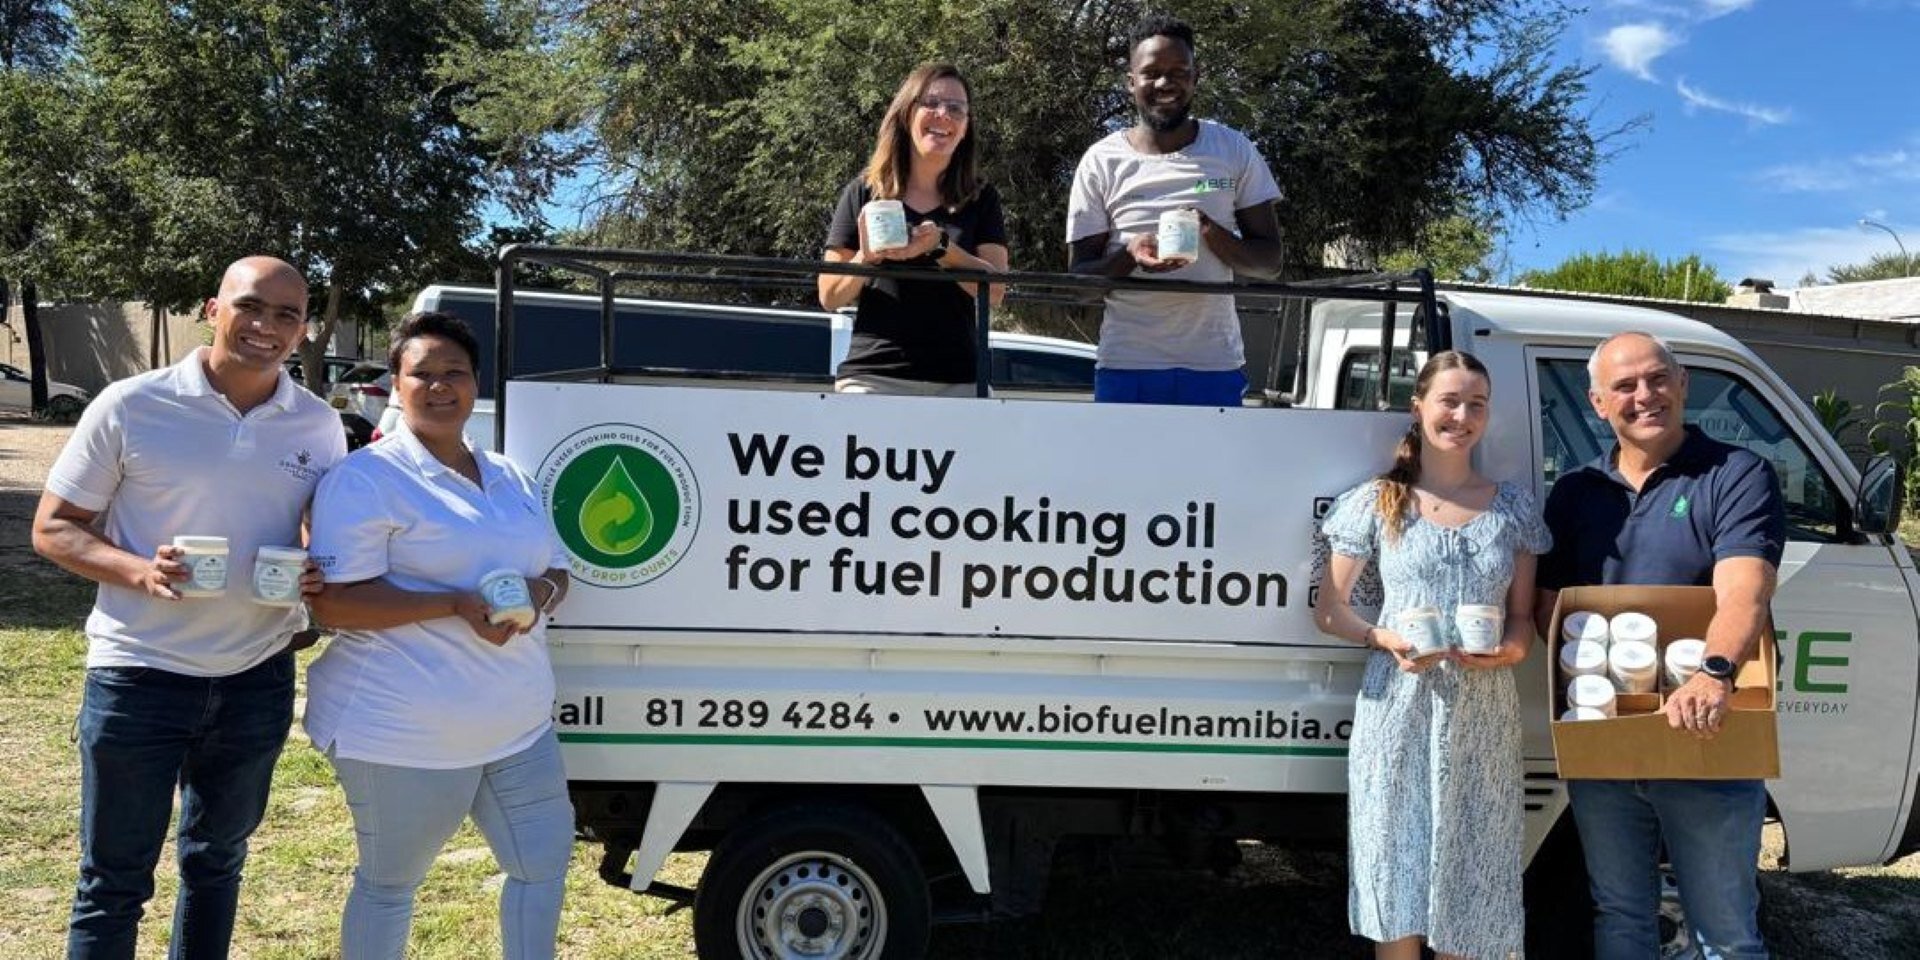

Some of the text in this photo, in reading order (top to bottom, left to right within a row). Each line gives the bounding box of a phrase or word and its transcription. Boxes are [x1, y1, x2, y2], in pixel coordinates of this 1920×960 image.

[554, 447, 574, 467] USED
[574, 432, 617, 450] COOKING
[619, 432, 640, 443] OILS
[641, 438, 660, 451] FOR
[659, 448, 676, 467] FUEL
[727, 432, 956, 495] We buy
[728, 491, 1215, 558] used cooking oil
[591, 568, 626, 582] DROP
[630, 548, 678, 580] COUNTS
[725, 544, 1288, 609] for fuel production
[551, 695, 603, 726] all
[646, 698, 683, 727] 81
[697, 699, 769, 729] 289
[782, 701, 874, 730] 4284
[1777, 701, 1848, 713] EVERYDAY
